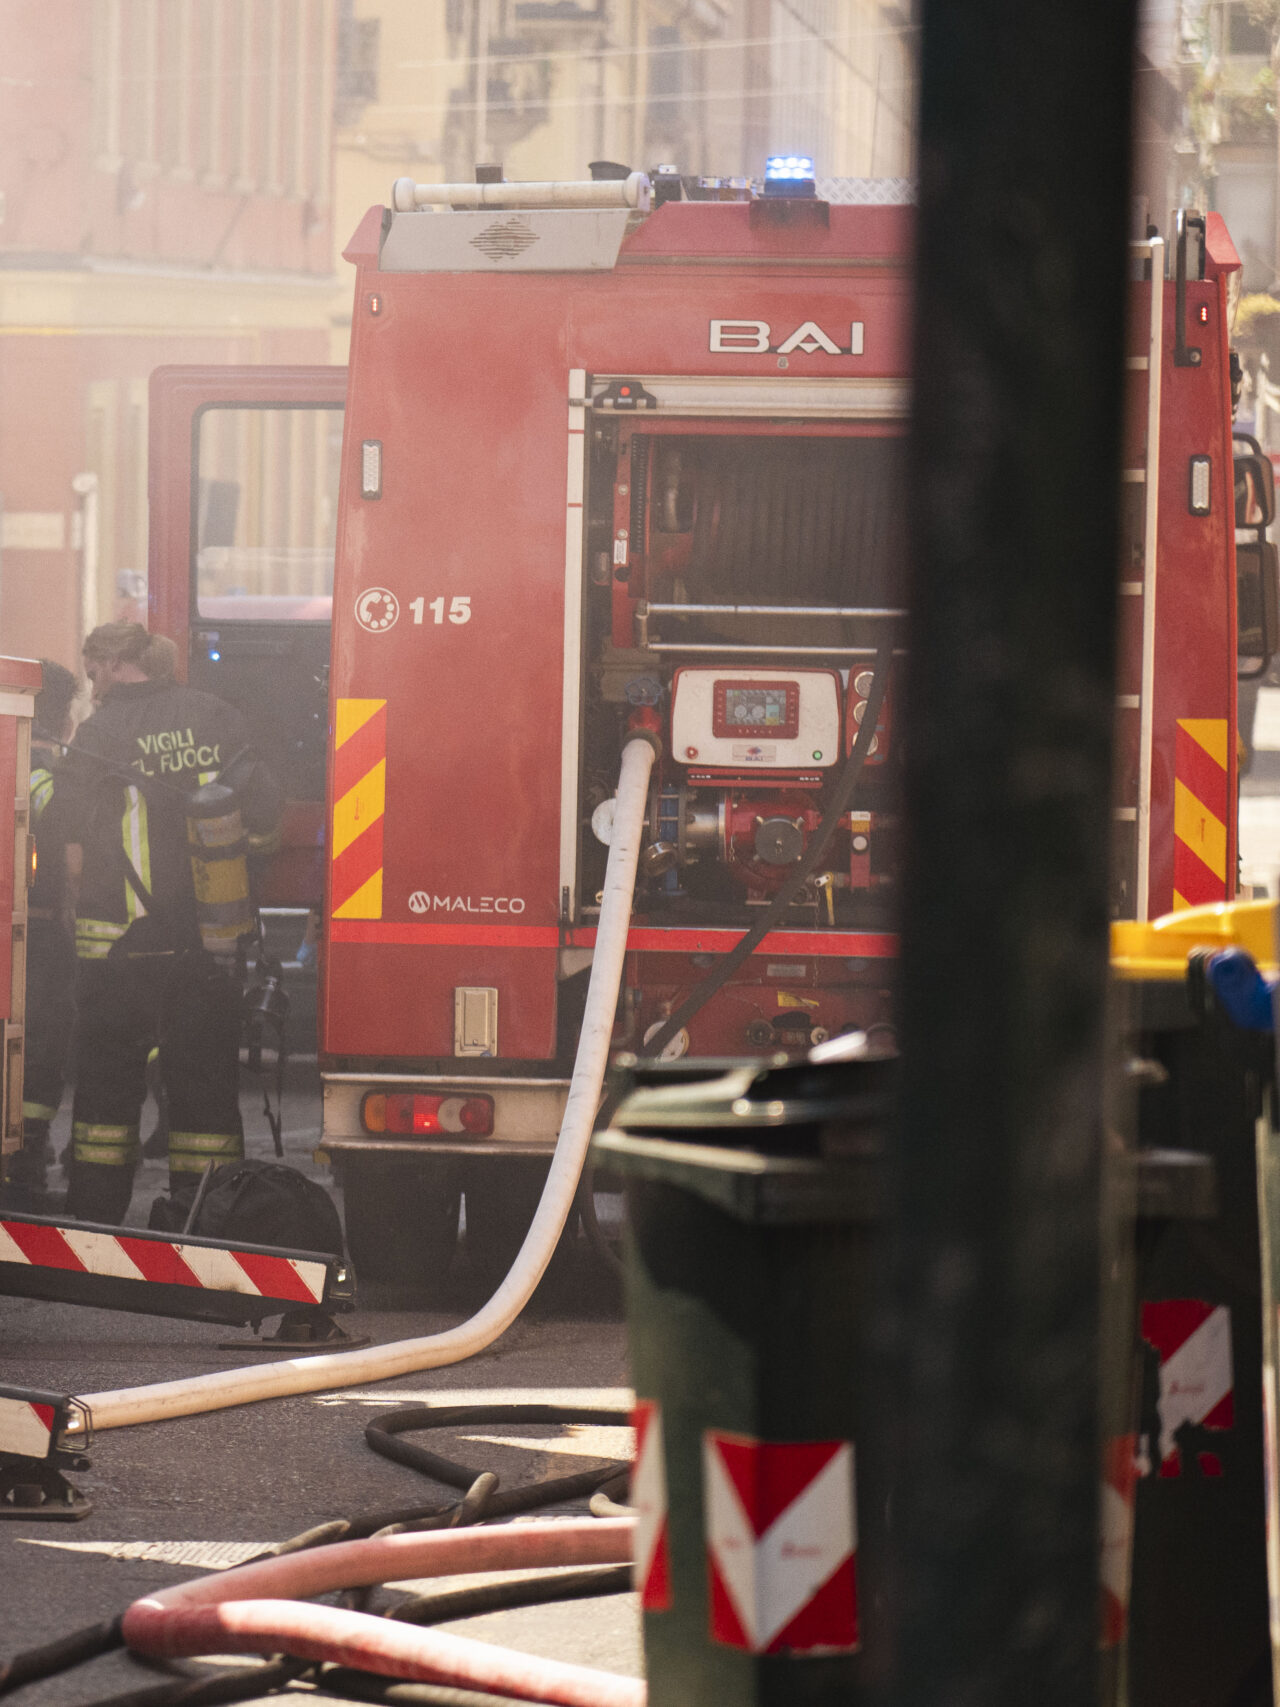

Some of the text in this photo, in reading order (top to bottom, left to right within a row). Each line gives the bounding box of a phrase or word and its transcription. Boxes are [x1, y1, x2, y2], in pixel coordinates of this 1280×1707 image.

[709, 319, 865, 354] BAI
[409, 596, 472, 625] 115
[136, 727, 195, 755] VIGILI
[433, 895, 526, 914] MALECO
